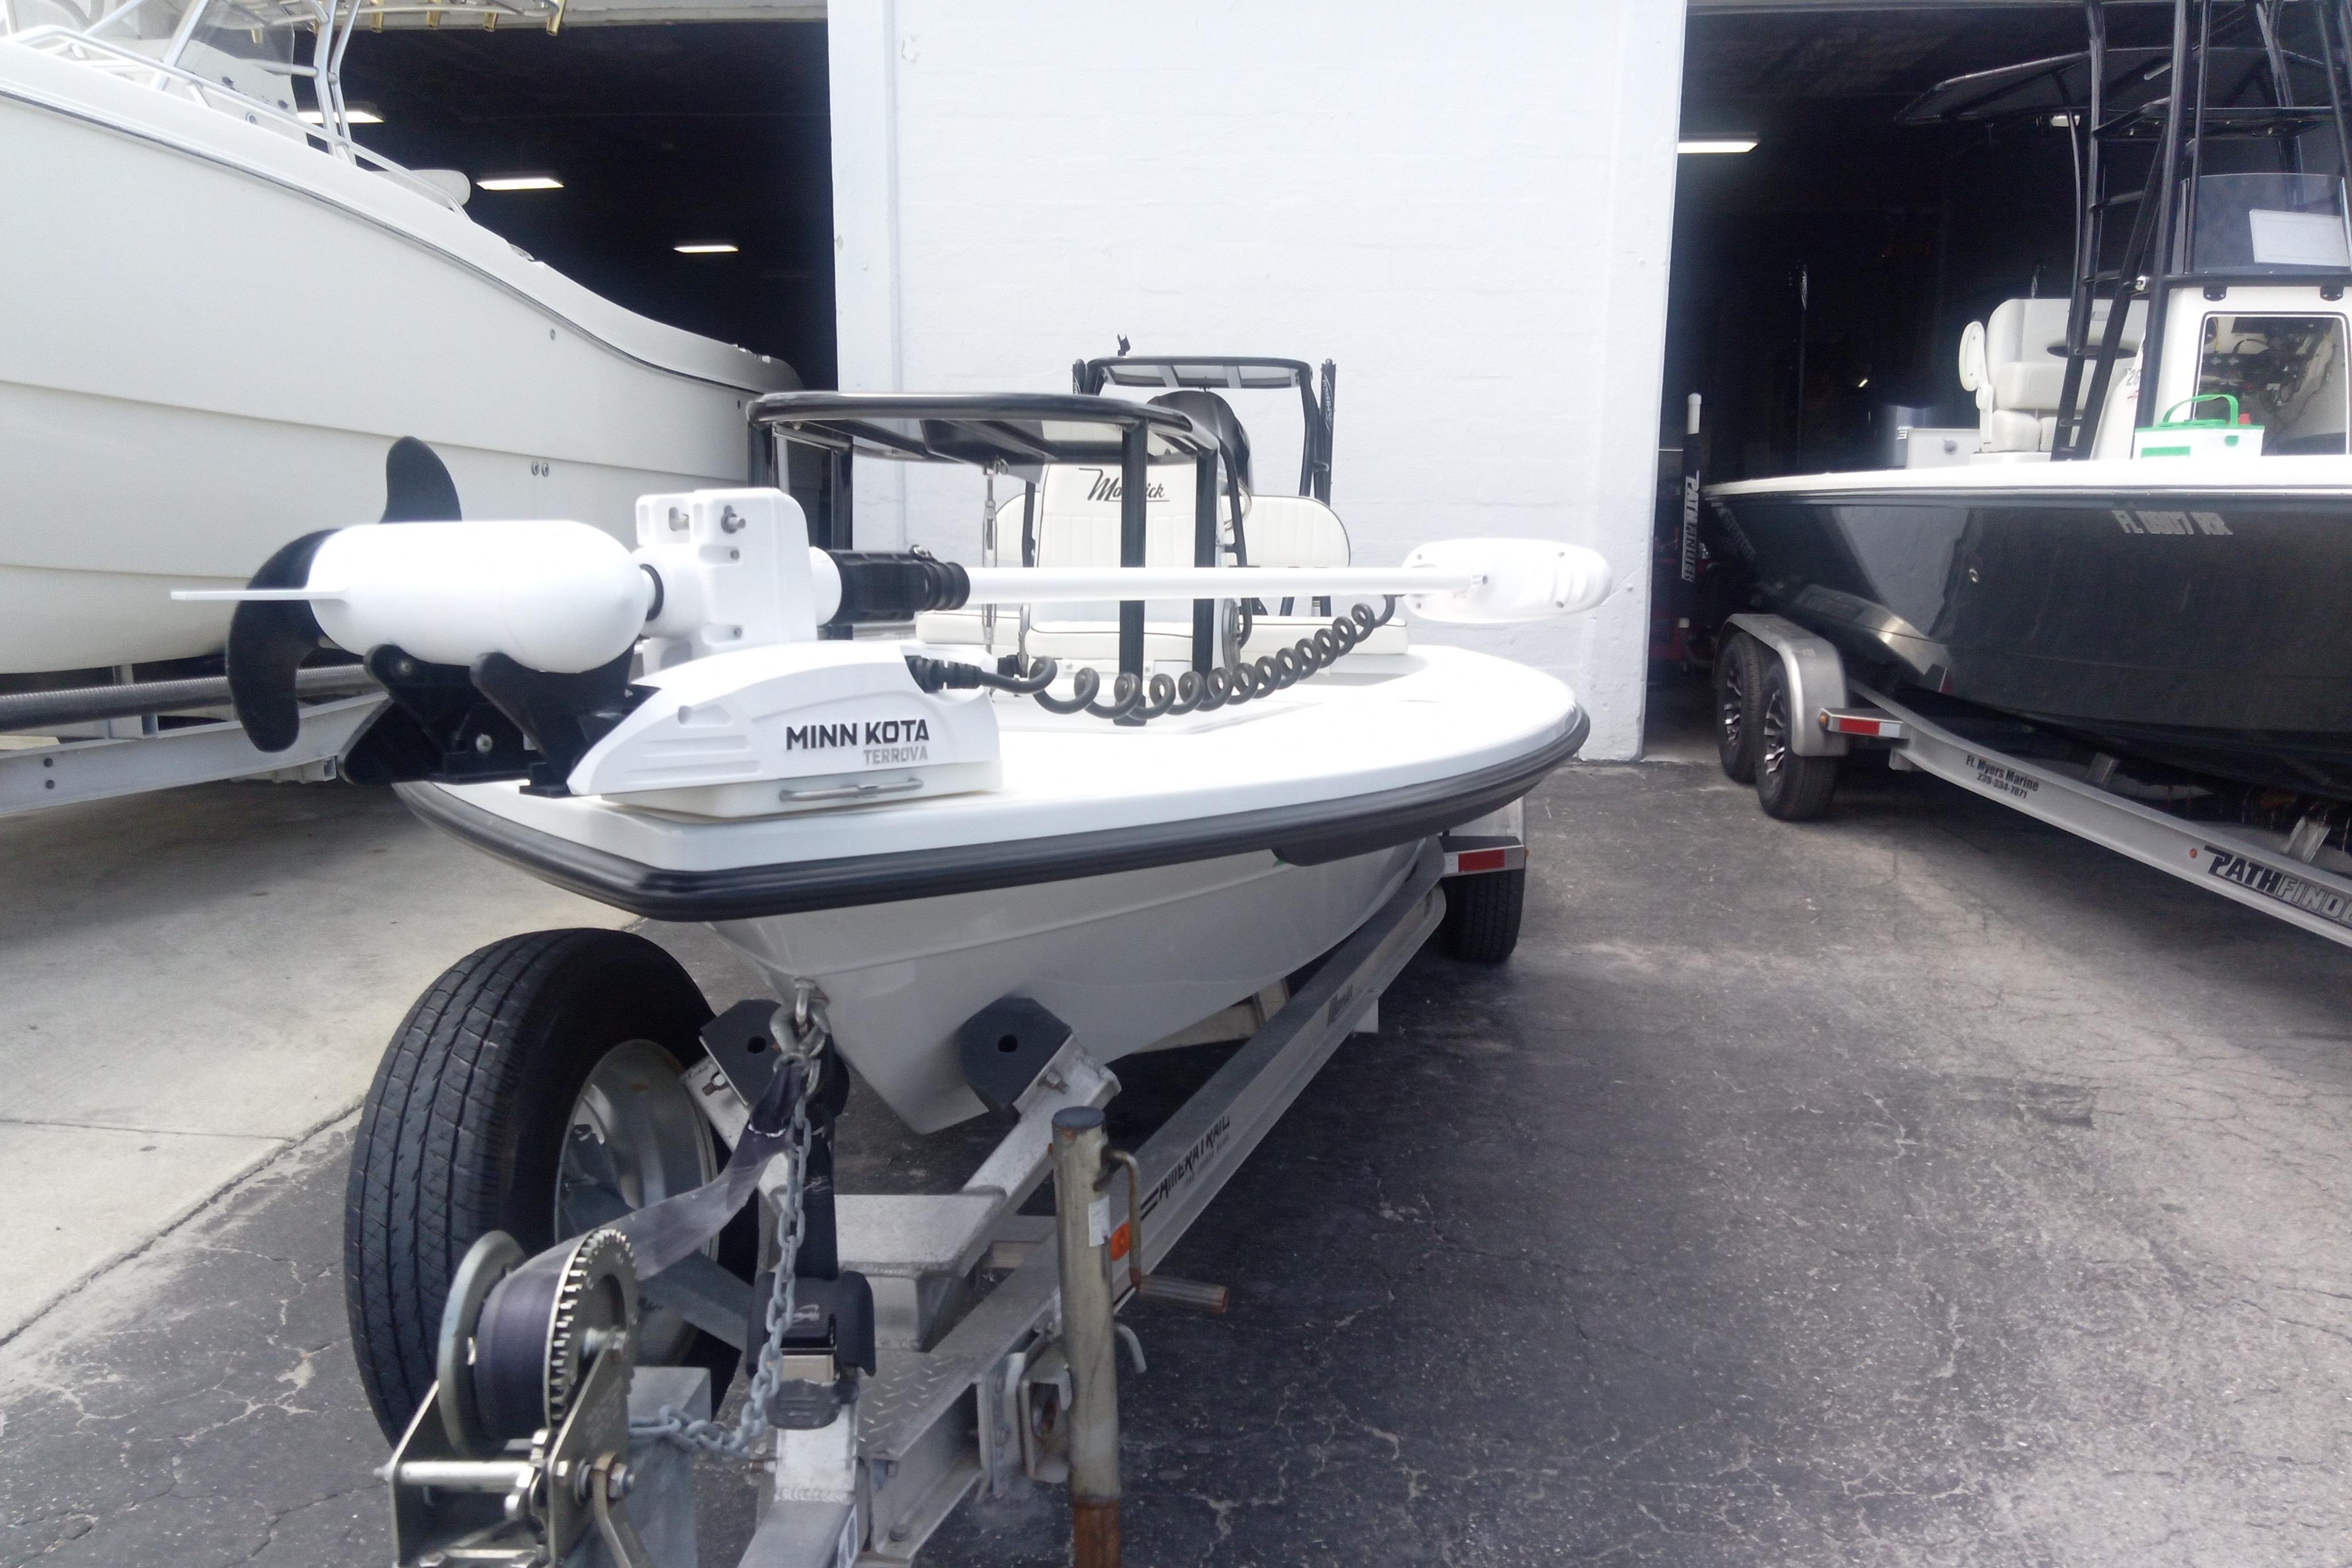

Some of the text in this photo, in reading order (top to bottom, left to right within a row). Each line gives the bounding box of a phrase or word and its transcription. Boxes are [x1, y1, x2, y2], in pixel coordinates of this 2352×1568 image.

[1079, 467, 1170, 502] Maick
[786, 719, 930, 750] MINN KOTA
[863, 746, 928, 765] TERROVA
[1977, 759, 2005, 779] Myers
[2006, 769, 2039, 792] Marine
